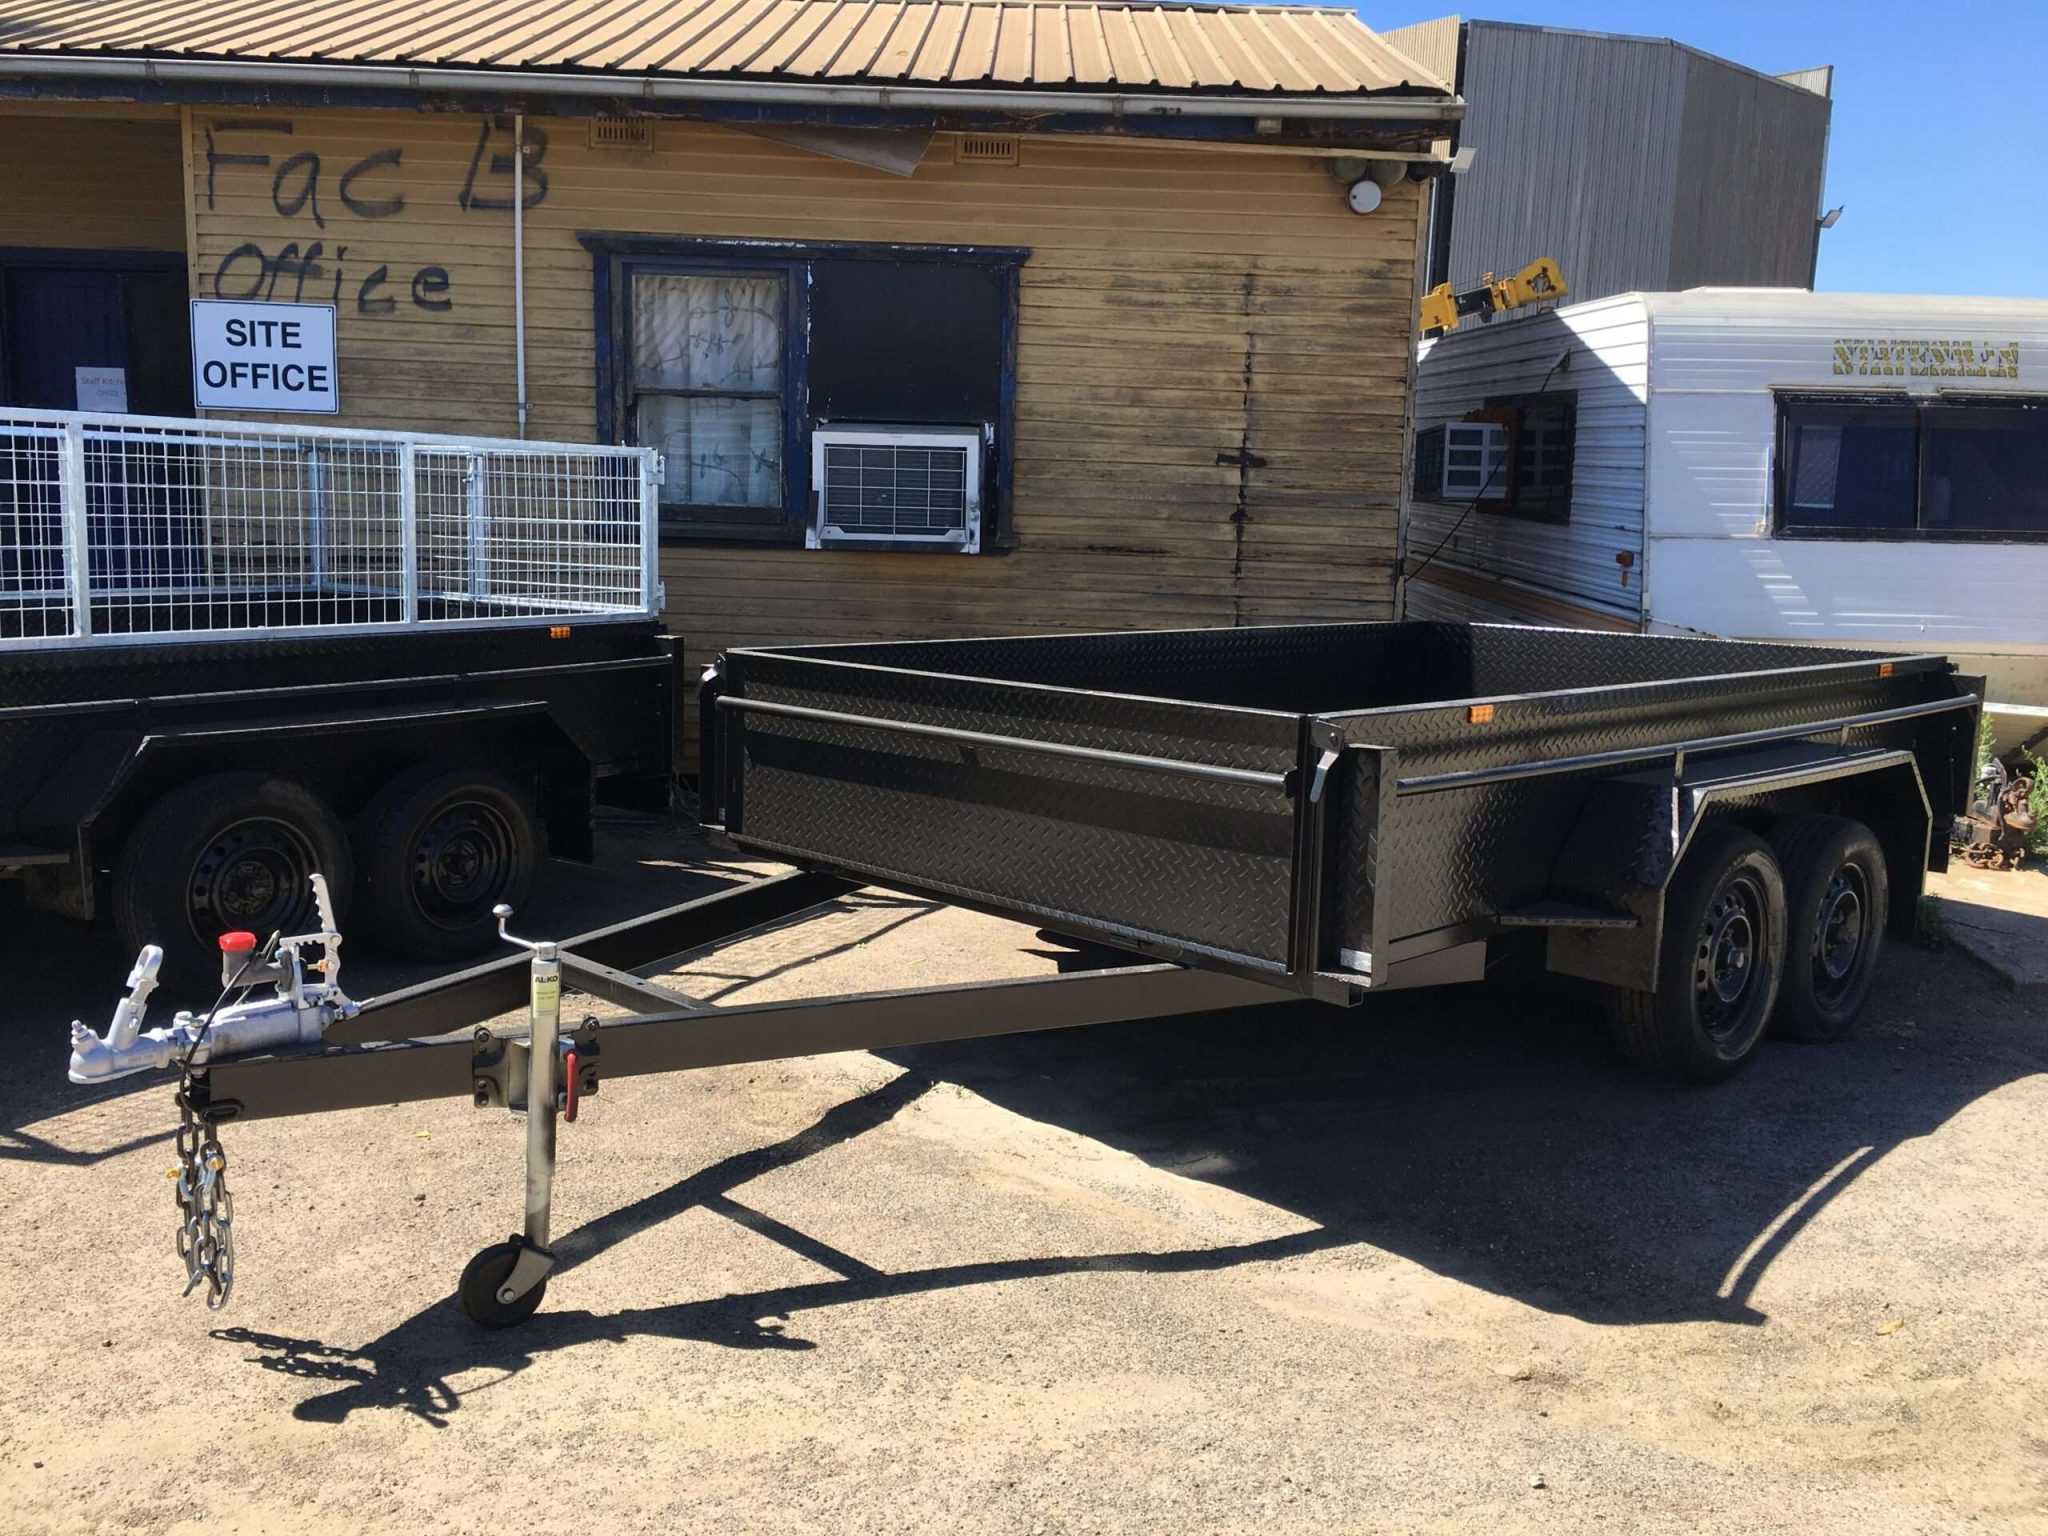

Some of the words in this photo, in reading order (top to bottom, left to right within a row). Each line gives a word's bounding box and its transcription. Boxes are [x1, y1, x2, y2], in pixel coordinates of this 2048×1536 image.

[205, 119, 405, 229] Fac
[213, 240, 453, 313] Office
[225, 318, 302, 349] SITE
[202, 360, 329, 393] OFFICE
